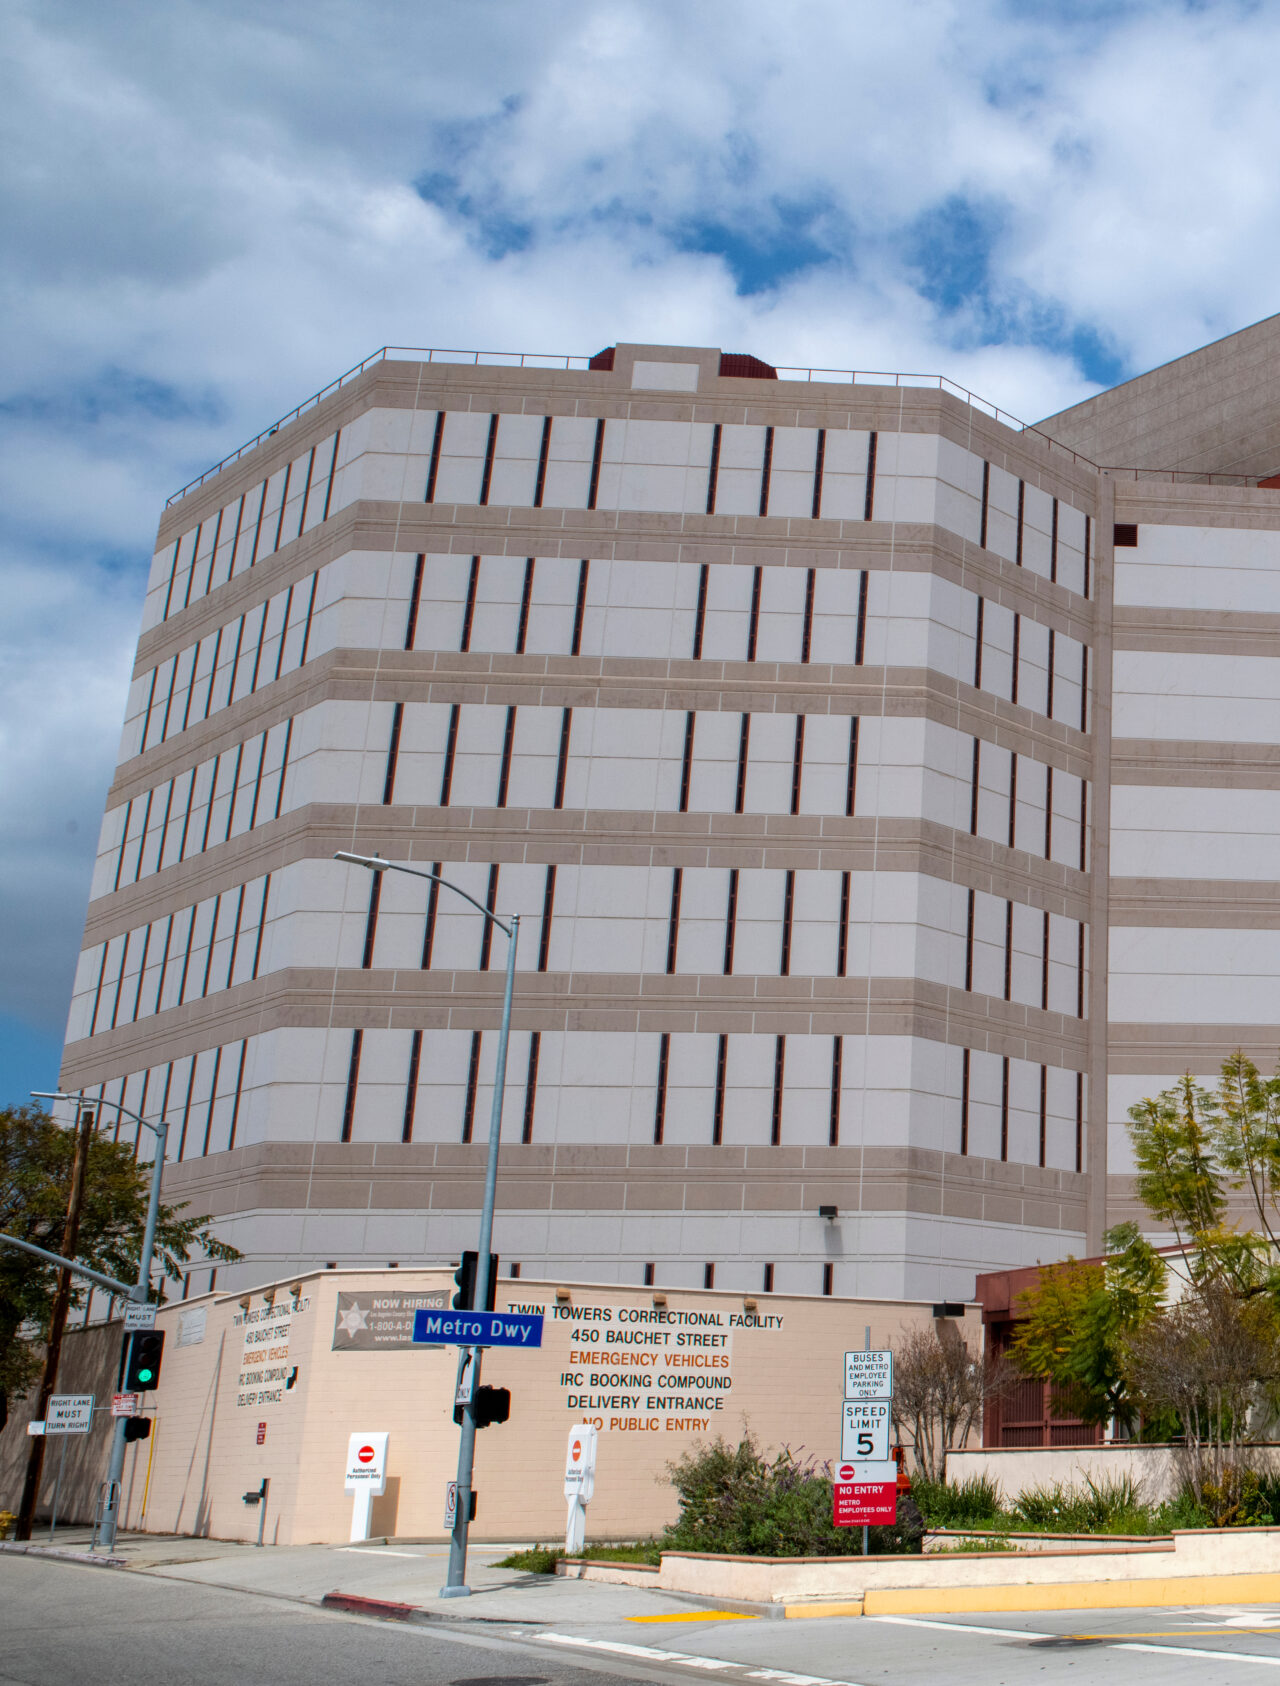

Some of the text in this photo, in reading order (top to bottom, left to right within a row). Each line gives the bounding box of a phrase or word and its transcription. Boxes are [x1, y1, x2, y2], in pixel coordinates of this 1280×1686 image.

[373, 1298, 444, 1309] NOW HIRING
[507, 1303, 784, 1329] TWIN TOWERS CORRECTIONAL FACILITY
[426, 1316, 532, 1342] Metro Dwy
[374, 1334, 412, 1342] www.las
[571, 1329, 728, 1347] 450 BAUCHET STREET
[569, 1351, 729, 1368] EMERGENCY VEHICLES
[853, 1354, 884, 1362] BUSES
[560, 1372, 732, 1389] IRC BOOKING COMPOUND
[567, 1395, 724, 1410] DELIVERY ENTRANCE
[56, 1410, 82, 1418] MUST
[846, 1406, 887, 1416] SPEED
[610, 1417, 660, 1431] PUBLIC
[666, 1418, 710, 1431] ENTRY
[850, 1419, 881, 1429] LIMIT
[856, 1433, 874, 1455] 5
[839, 1485, 884, 1495] NO ENTRY
[838, 1506, 875, 1514] EMPLOYEES
